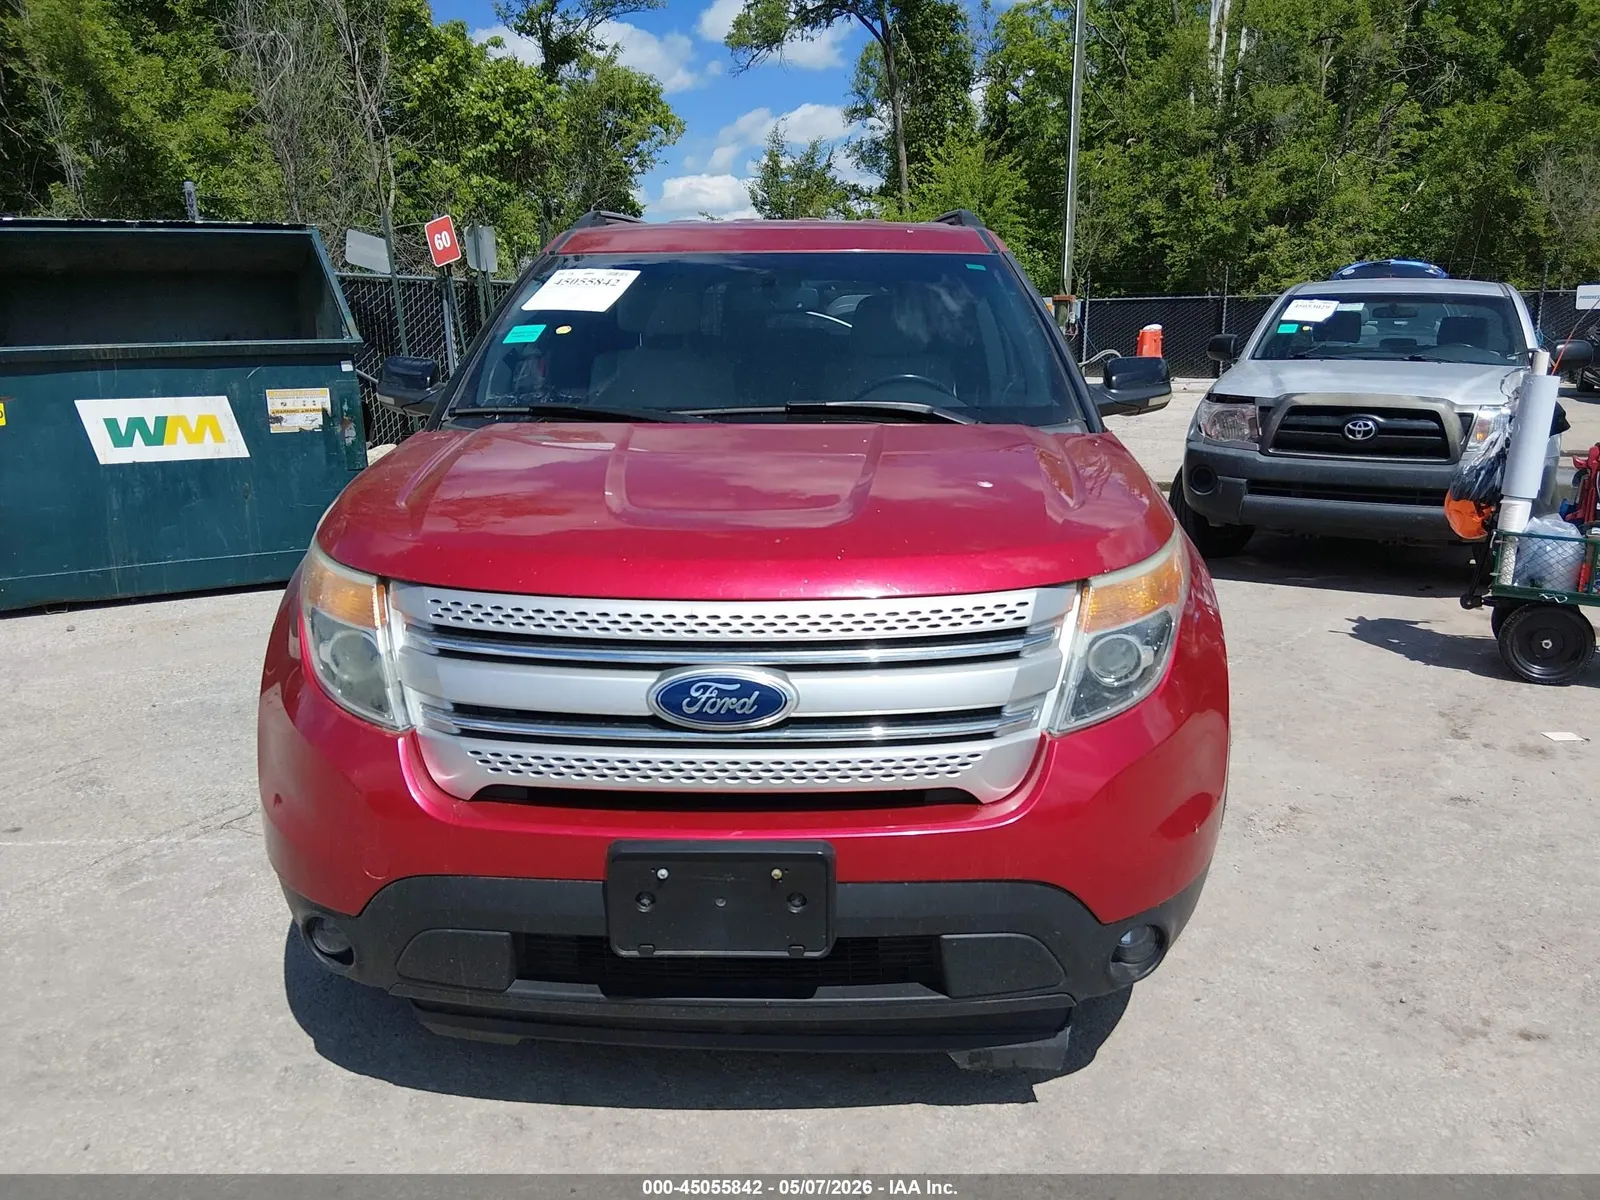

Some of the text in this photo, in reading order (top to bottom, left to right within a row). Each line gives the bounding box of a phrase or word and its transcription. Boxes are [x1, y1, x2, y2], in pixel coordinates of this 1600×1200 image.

[434, 230, 451, 251] 60
[102, 414, 226, 449] WM
[682, 681, 760, 715] Ford
